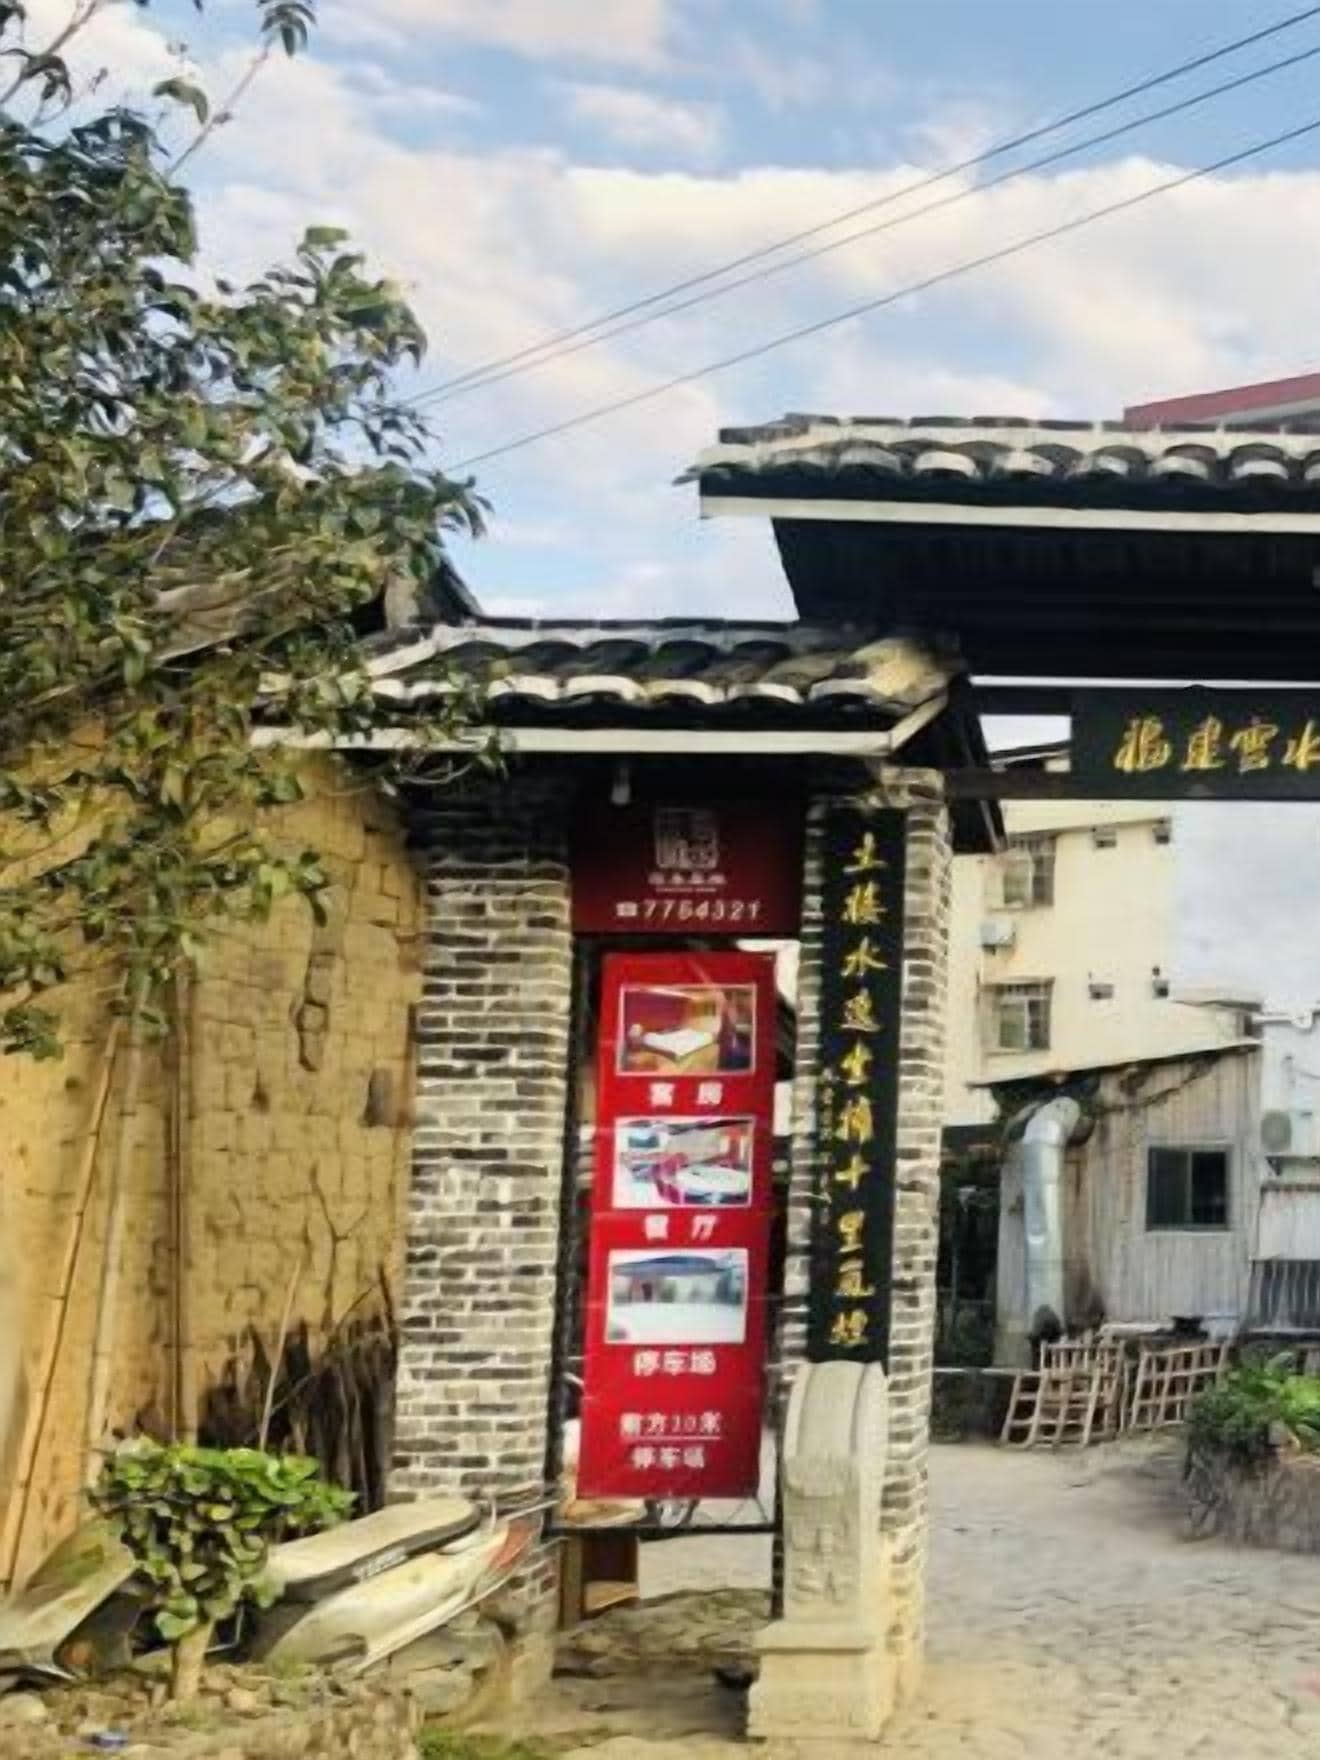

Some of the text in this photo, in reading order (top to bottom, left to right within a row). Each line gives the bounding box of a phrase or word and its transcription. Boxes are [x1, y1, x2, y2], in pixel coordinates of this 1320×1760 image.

[643, 1214, 718, 1241] 餐厅
[632, 1350, 717, 1377] 停车场
[631, 1445, 705, 1469] 停车场
